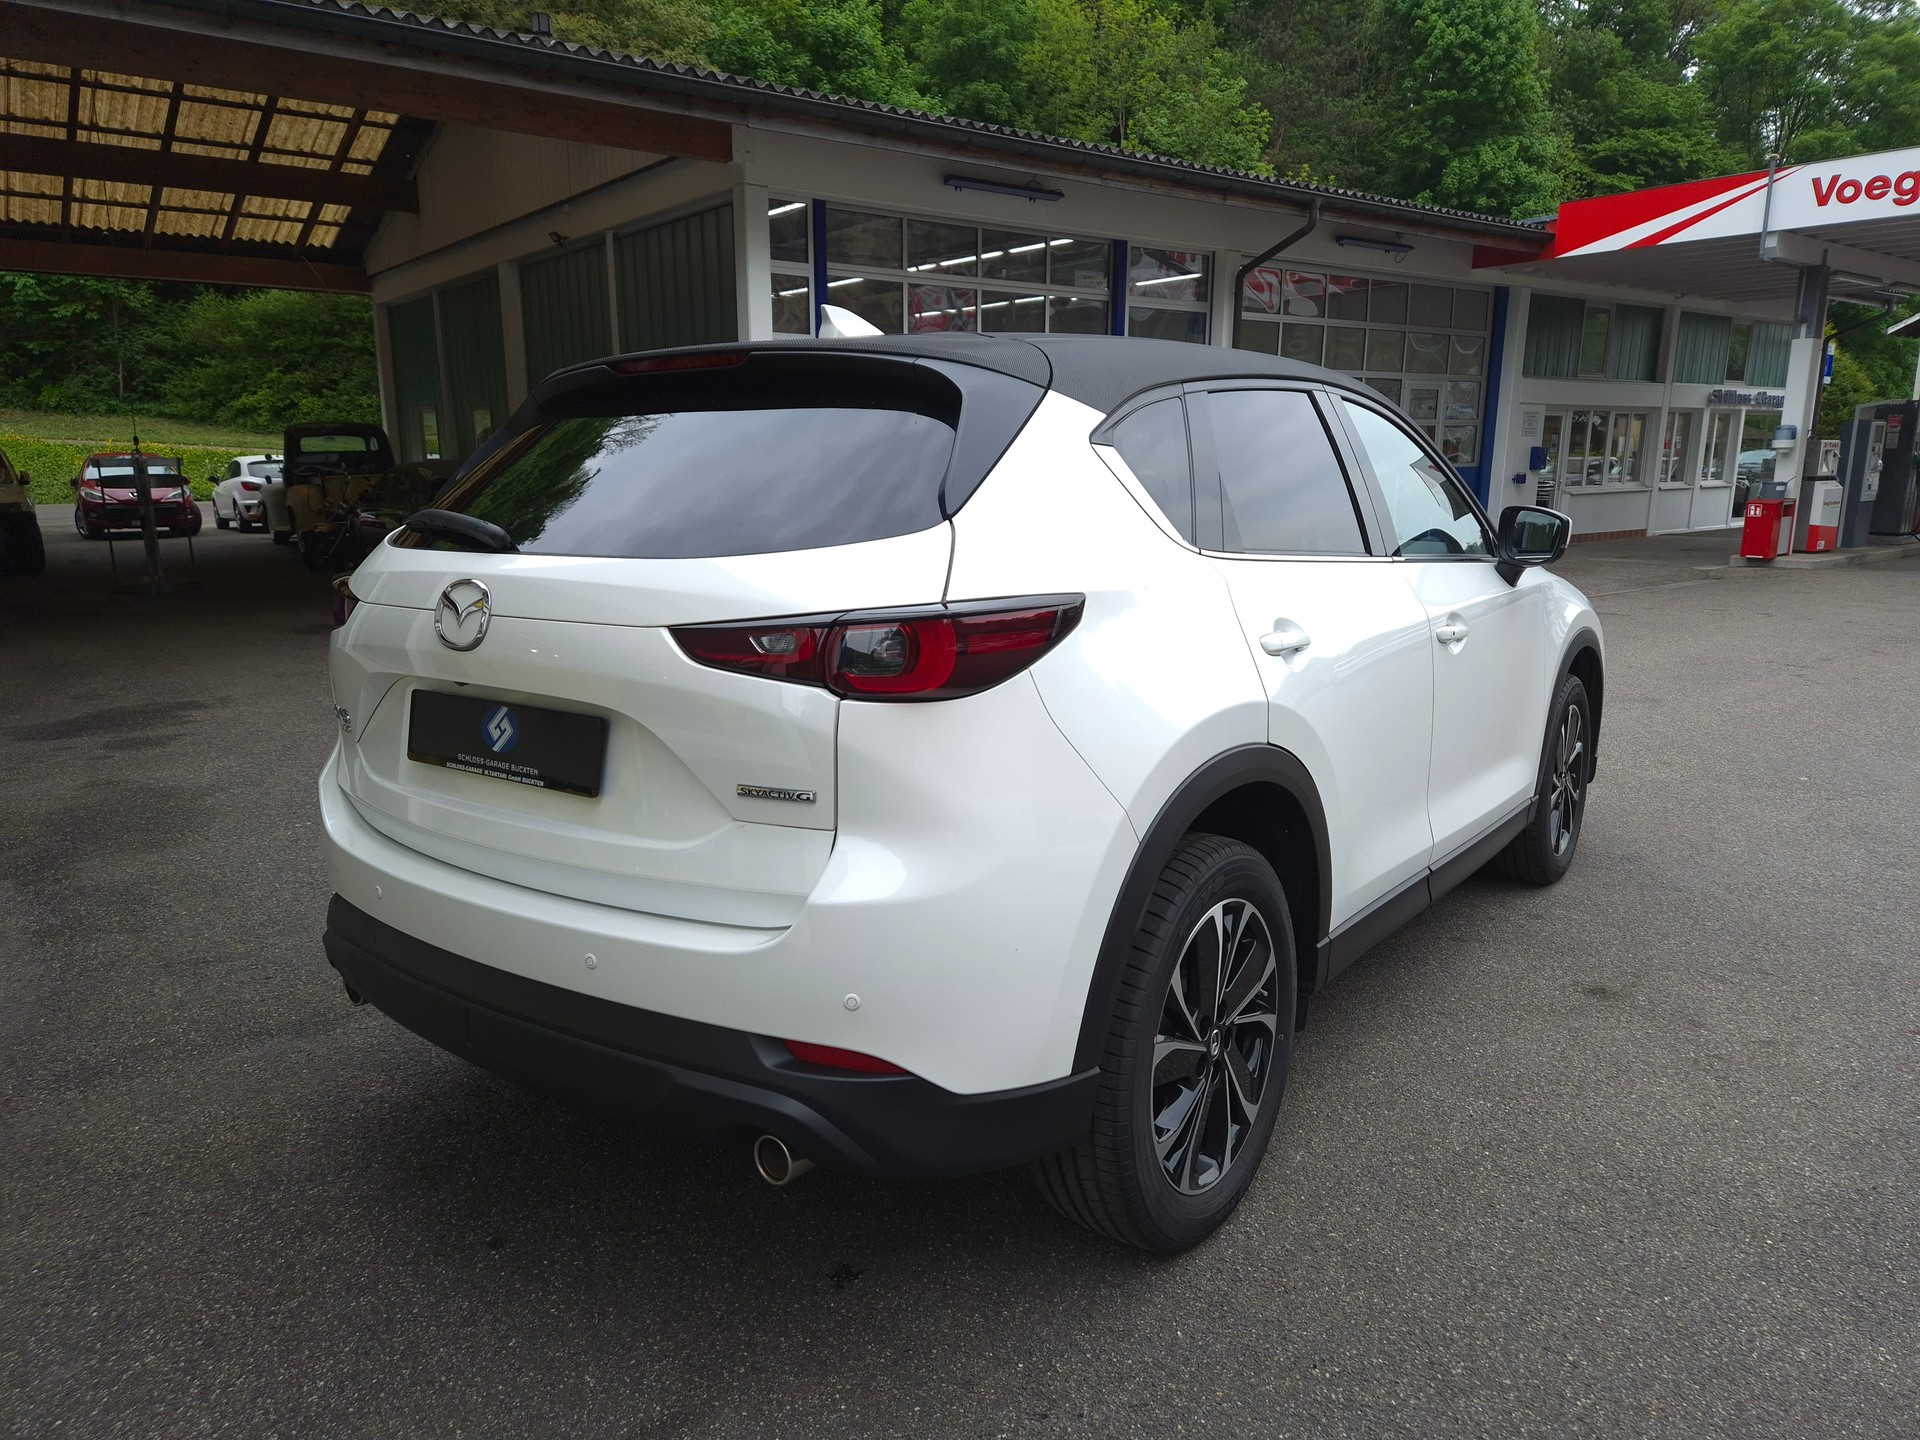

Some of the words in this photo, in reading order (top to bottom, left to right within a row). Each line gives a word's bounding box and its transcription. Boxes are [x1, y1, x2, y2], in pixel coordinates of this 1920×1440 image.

[1811, 170, 1920, 207] Voeg
[446, 761, 483, 774] SCHLOSS-GARAGE
[521, 777, 545, 787] BUCKTEN
[457, 753, 510, 770] SCHLOSS-GARAGE
[510, 764, 539, 776] BUCKTEN
